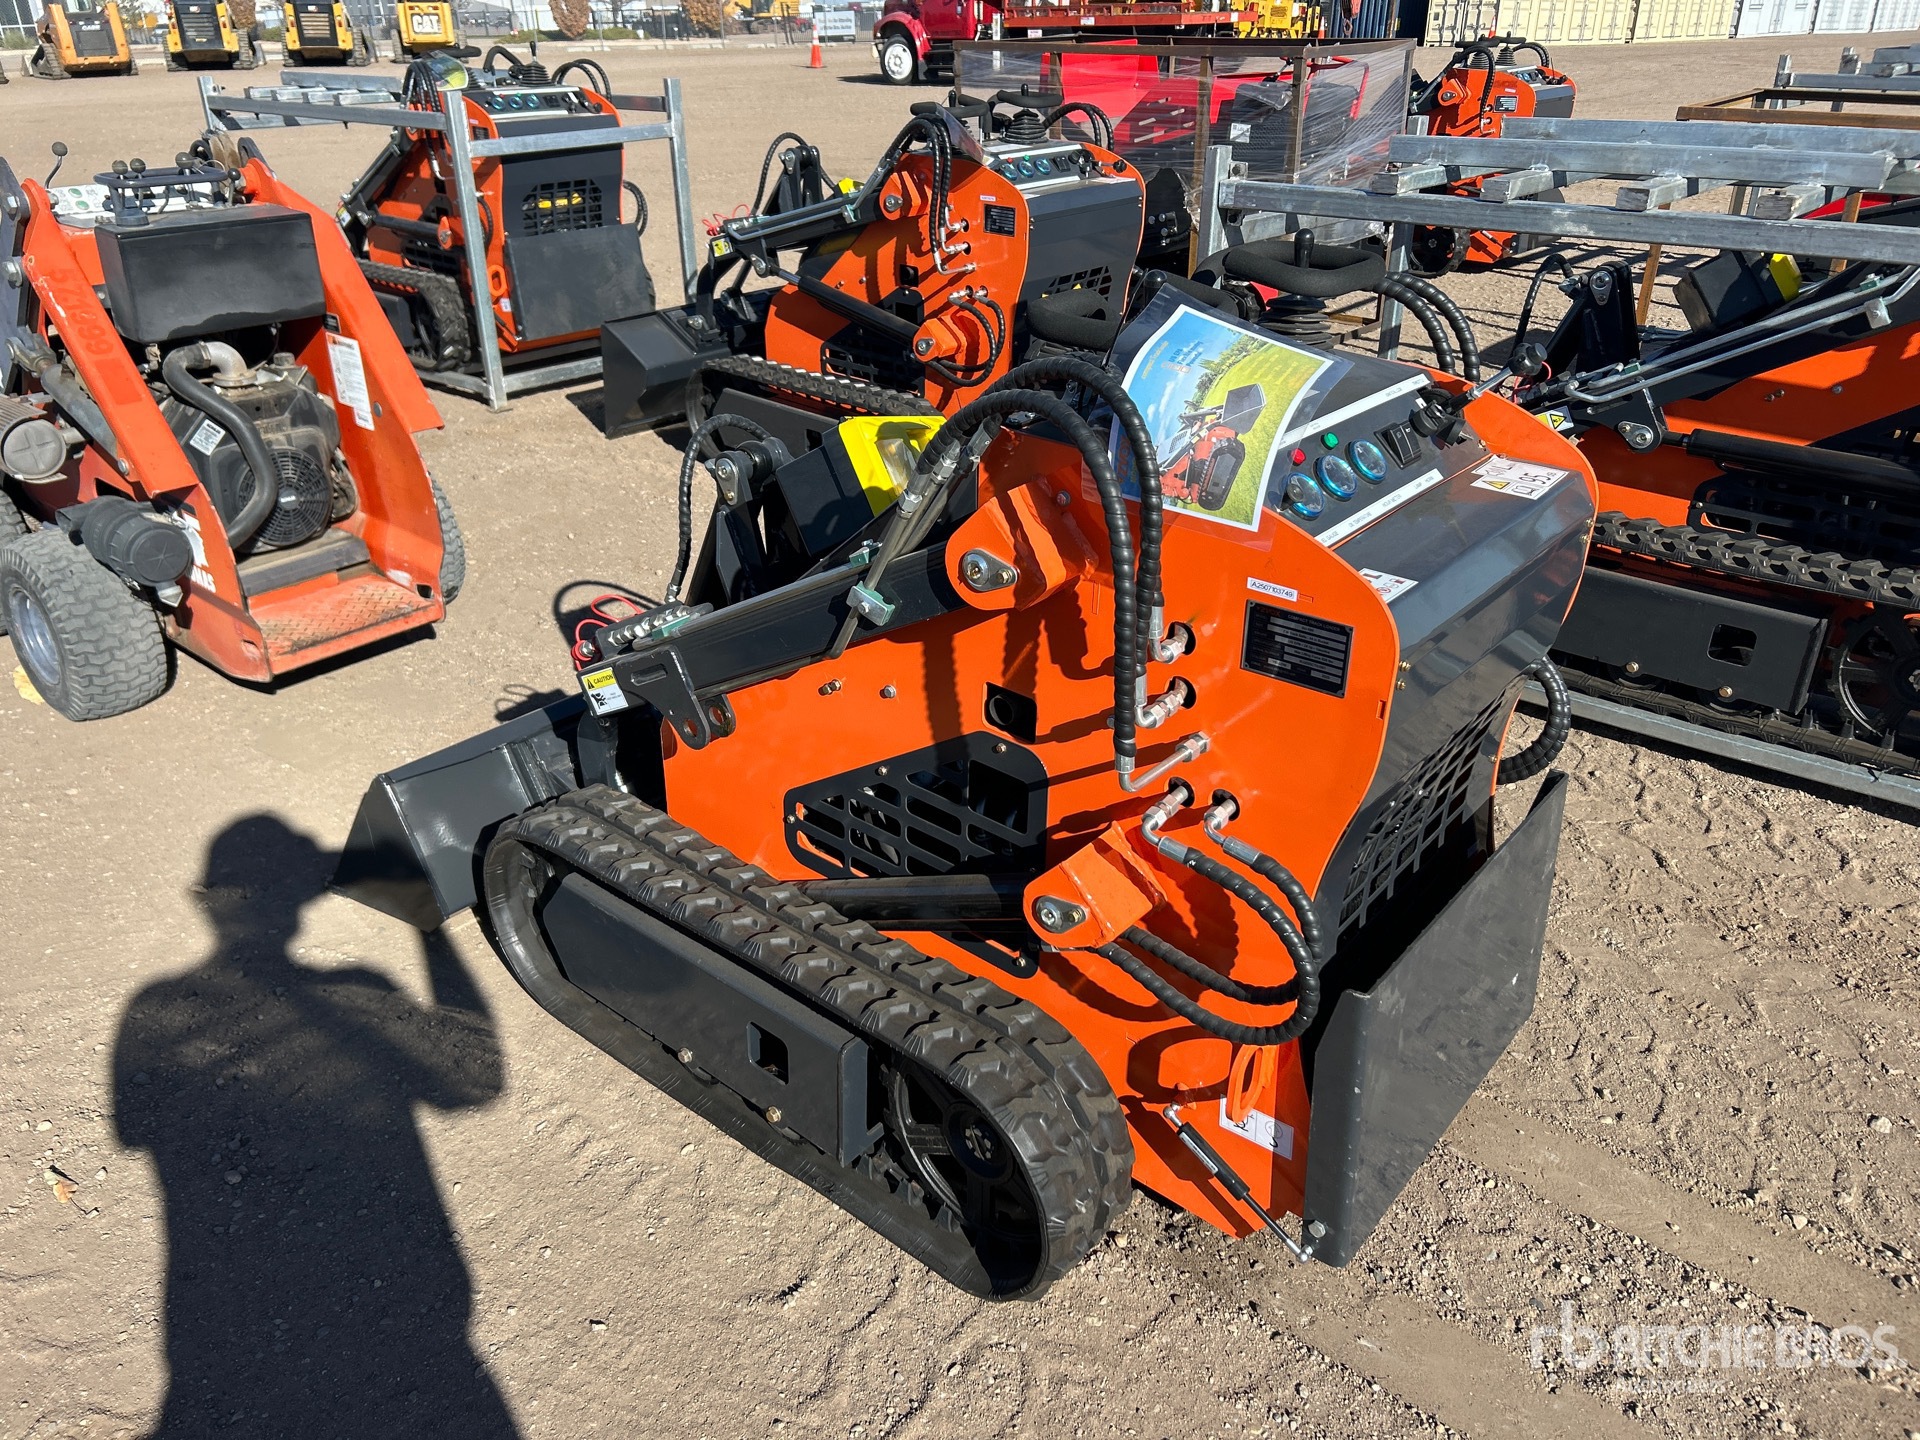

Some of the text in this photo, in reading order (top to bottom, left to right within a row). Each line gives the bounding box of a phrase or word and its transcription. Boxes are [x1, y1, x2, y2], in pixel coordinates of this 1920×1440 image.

[412, 15, 438, 33] CAT
[1519, 472, 1551, 484] 95
[1251, 581, 1293, 598] A2507103749
[593, 674, 614, 684] CAUTION
